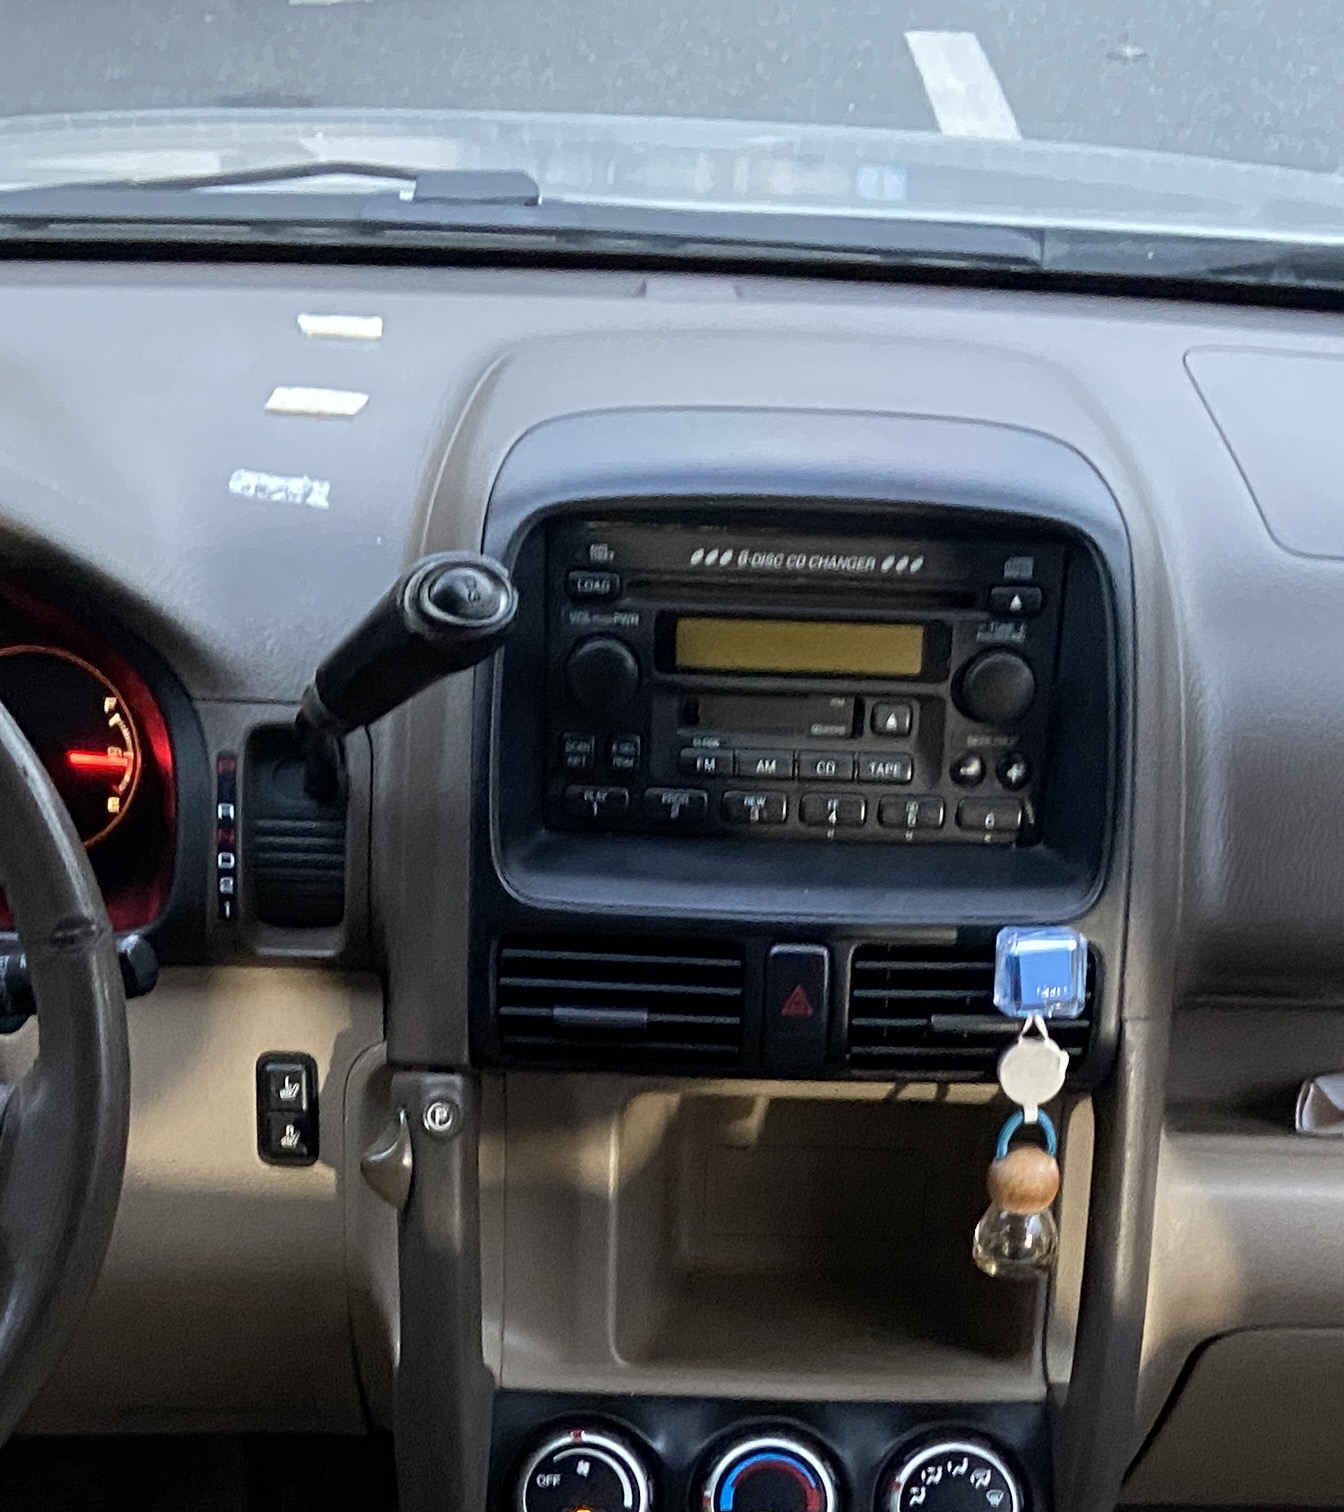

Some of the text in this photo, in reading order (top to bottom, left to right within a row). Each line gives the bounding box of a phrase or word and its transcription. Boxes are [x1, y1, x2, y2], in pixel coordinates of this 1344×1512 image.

[786, 553, 806, 570] CD
[809, 555, 876, 571] CHANGER
[696, 757, 716, 772] FM
[756, 759, 777, 774] AM
[816, 760, 836, 776] CD
[868, 761, 901, 777] TAPE
[218, 852, 235, 869] D
